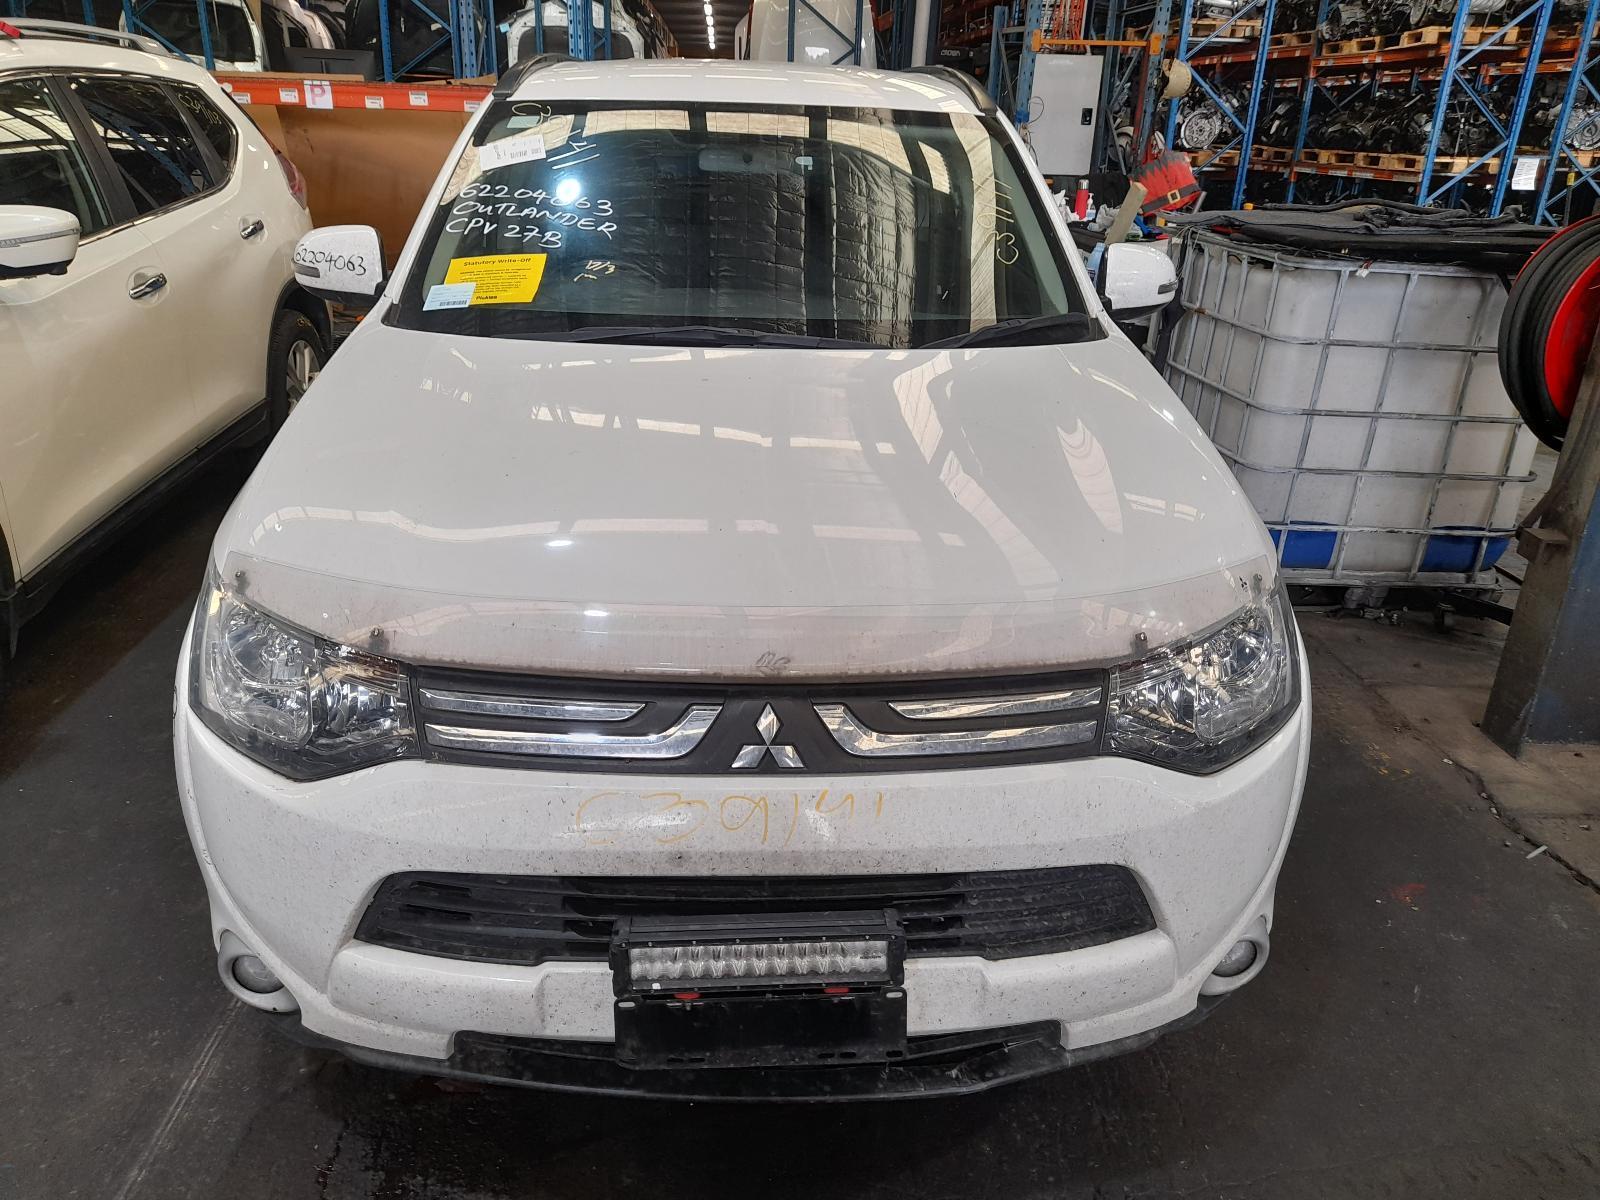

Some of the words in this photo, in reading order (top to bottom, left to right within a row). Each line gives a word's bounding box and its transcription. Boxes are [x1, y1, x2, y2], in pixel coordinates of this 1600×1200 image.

[445, 217, 498, 235] CPV
[503, 224, 563, 249] 27B
[452, 201, 618, 240] OUTLANDER
[497, 257, 532, 265] Write-Off
